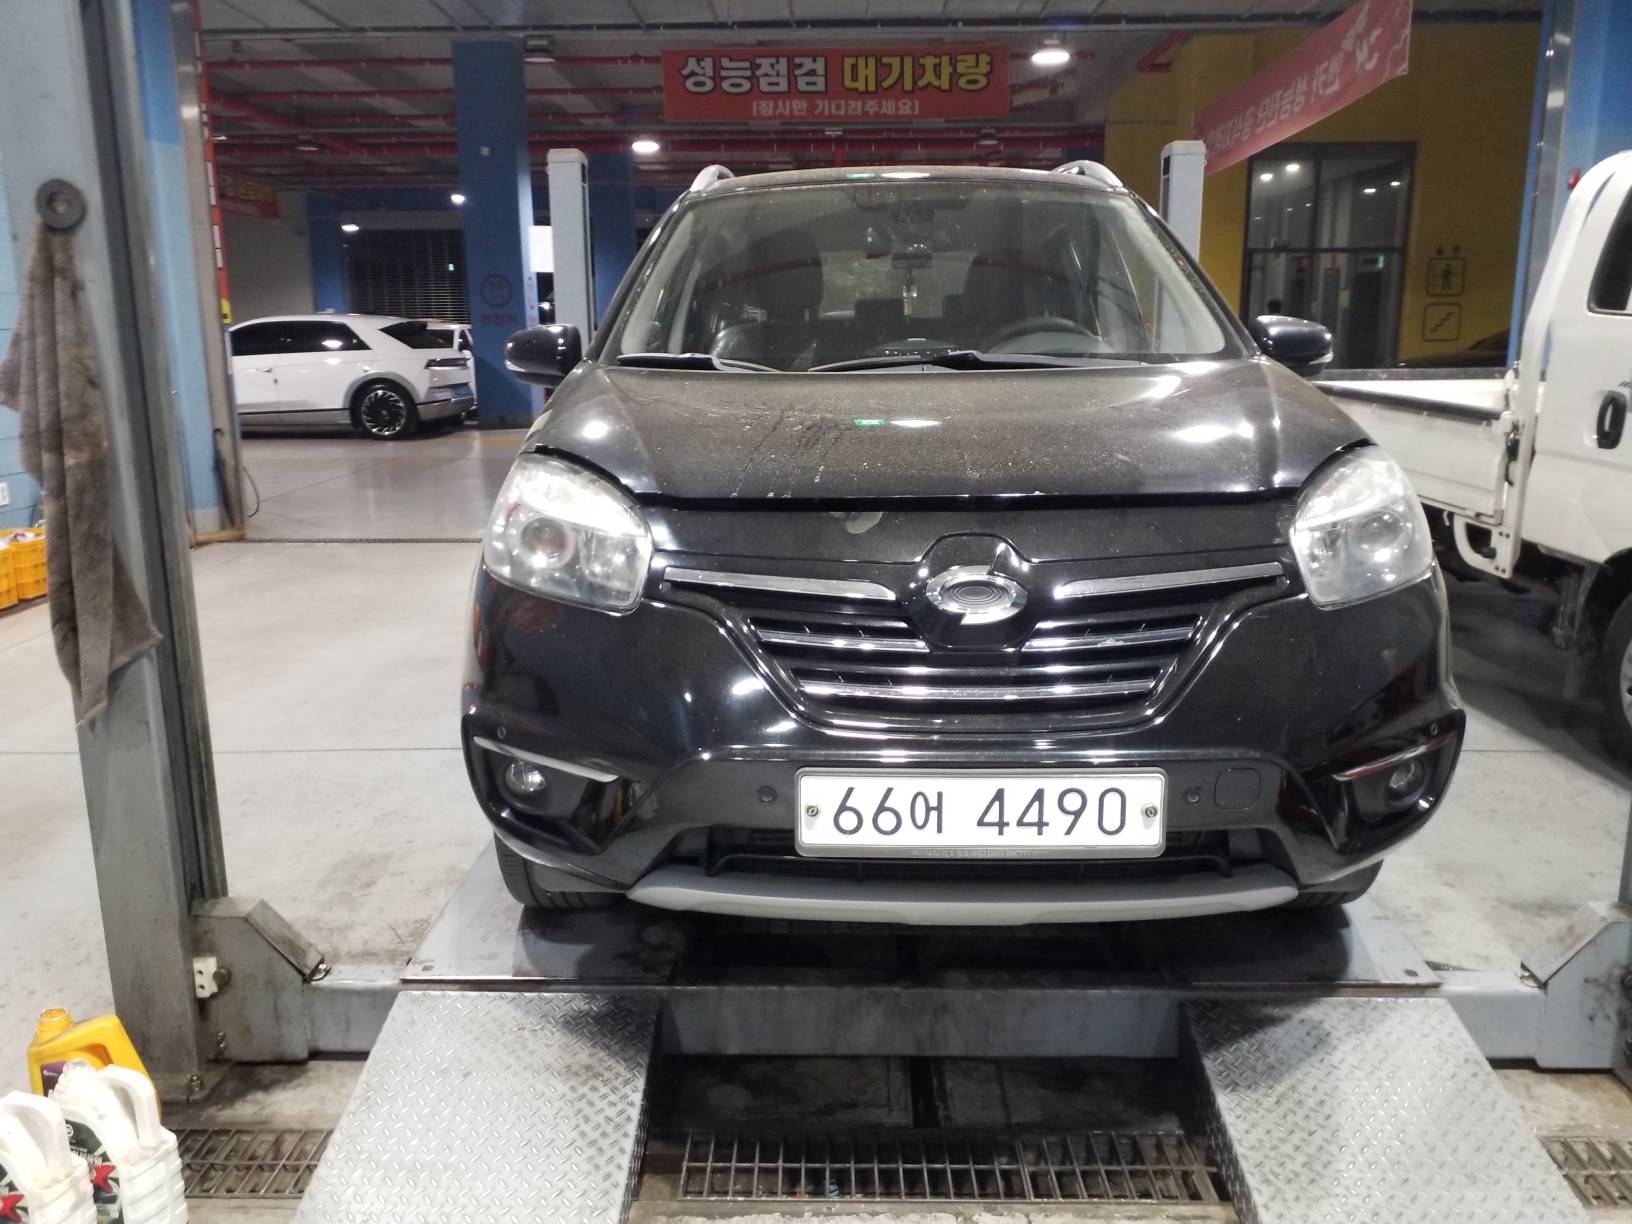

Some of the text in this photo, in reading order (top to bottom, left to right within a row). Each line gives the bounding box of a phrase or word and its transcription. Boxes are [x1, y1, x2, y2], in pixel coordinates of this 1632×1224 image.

[680, 53, 991, 94] 성능점검 대기차량
[815, 99, 920, 116] 기다려주세요]
[833, 786, 1127, 836] 66어 4490
